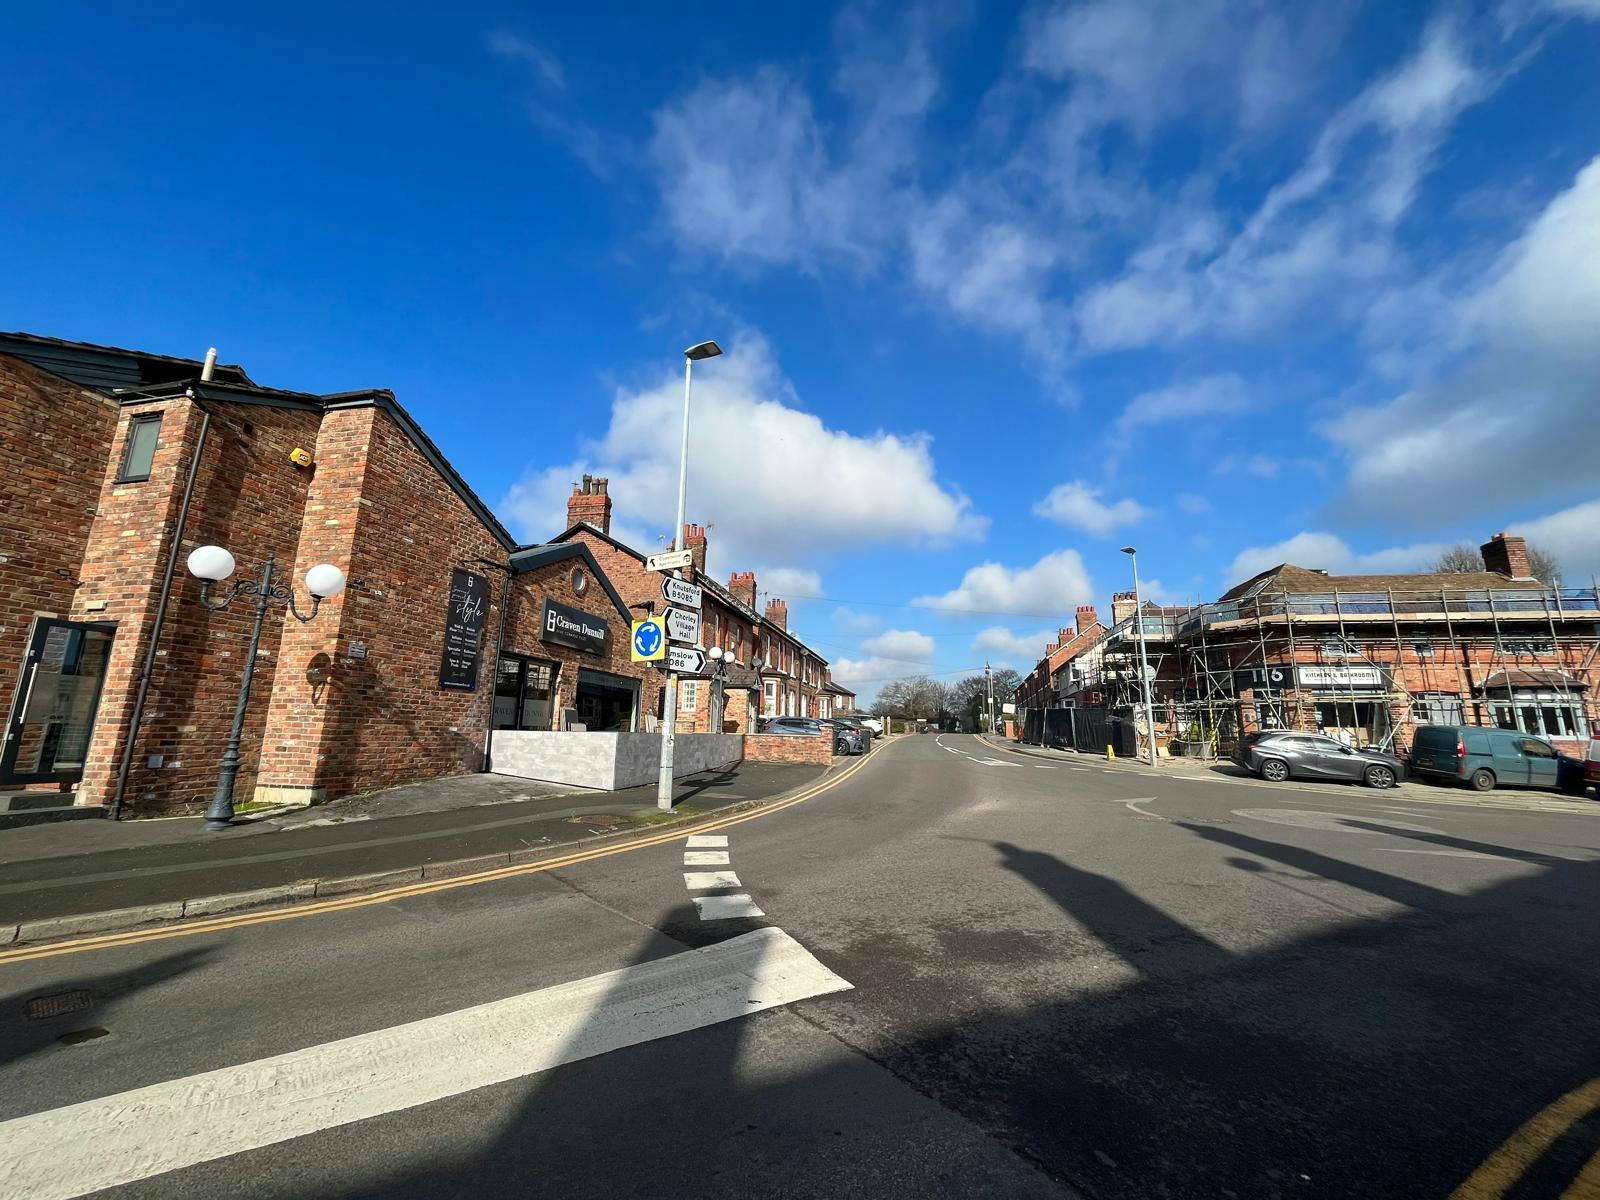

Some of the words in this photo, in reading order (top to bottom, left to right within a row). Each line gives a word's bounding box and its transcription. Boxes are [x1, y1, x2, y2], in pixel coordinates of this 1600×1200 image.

[672, 582, 700, 596] Knutsford
[674, 611, 696, 624] Chorley
[556, 615, 581, 632] Craven
[581, 623, 605, 640] Dunnill
[675, 620, 695, 632] Village
[679, 631, 691, 639] Hall
[667, 649, 694, 660] lmslow
